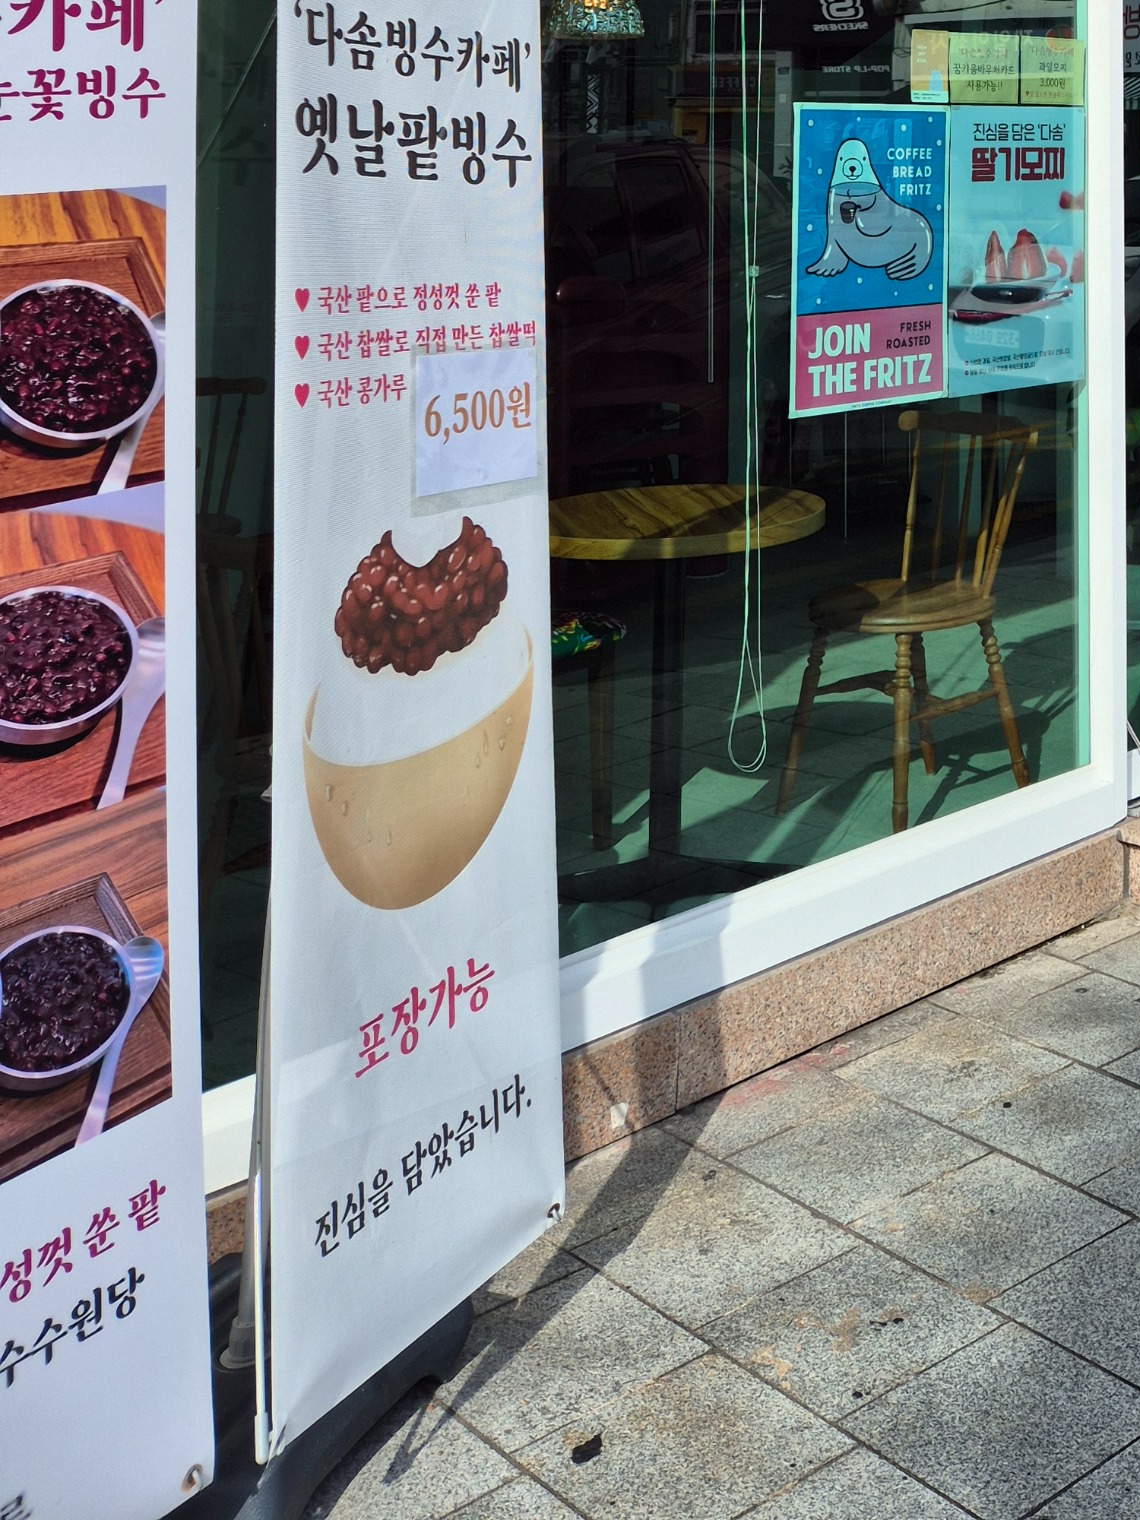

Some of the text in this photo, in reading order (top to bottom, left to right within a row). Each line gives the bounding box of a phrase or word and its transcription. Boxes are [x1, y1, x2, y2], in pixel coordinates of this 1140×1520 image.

[973, 123, 1009, 142] 진심을
[1011, 123, 1036, 142] 담은
[887, 147, 933, 161] COFFEE
[892, 165, 932, 178] BREAD
[971, 147, 1066, 183] 딸기모찌
[899, 184, 932, 196] FRITZ
[318, 285, 352, 315] 국산
[357, 284, 408, 313] 팥으로
[413, 283, 460, 311] 정성껏
[485, 282, 501, 308] 팥
[318, 320, 537, 362] 국산 찹쌀로 직접 만든 찹쌀떡
[808, 322, 870, 359] JOIN
[886, 335, 931, 350] ROASTED
[900, 320, 931, 333] FRESH
[318, 373, 408, 409] 국산 콩가루
[808, 361, 857, 397] THE
[863, 352, 933, 391] FRITZ
[424, 381, 532, 444] 6,500원
[355, 958, 495, 1078] 포장가능
[314, 1074, 532, 1257] 진심을 담았습니다.
[128, 1179, 167, 1231] 팥
